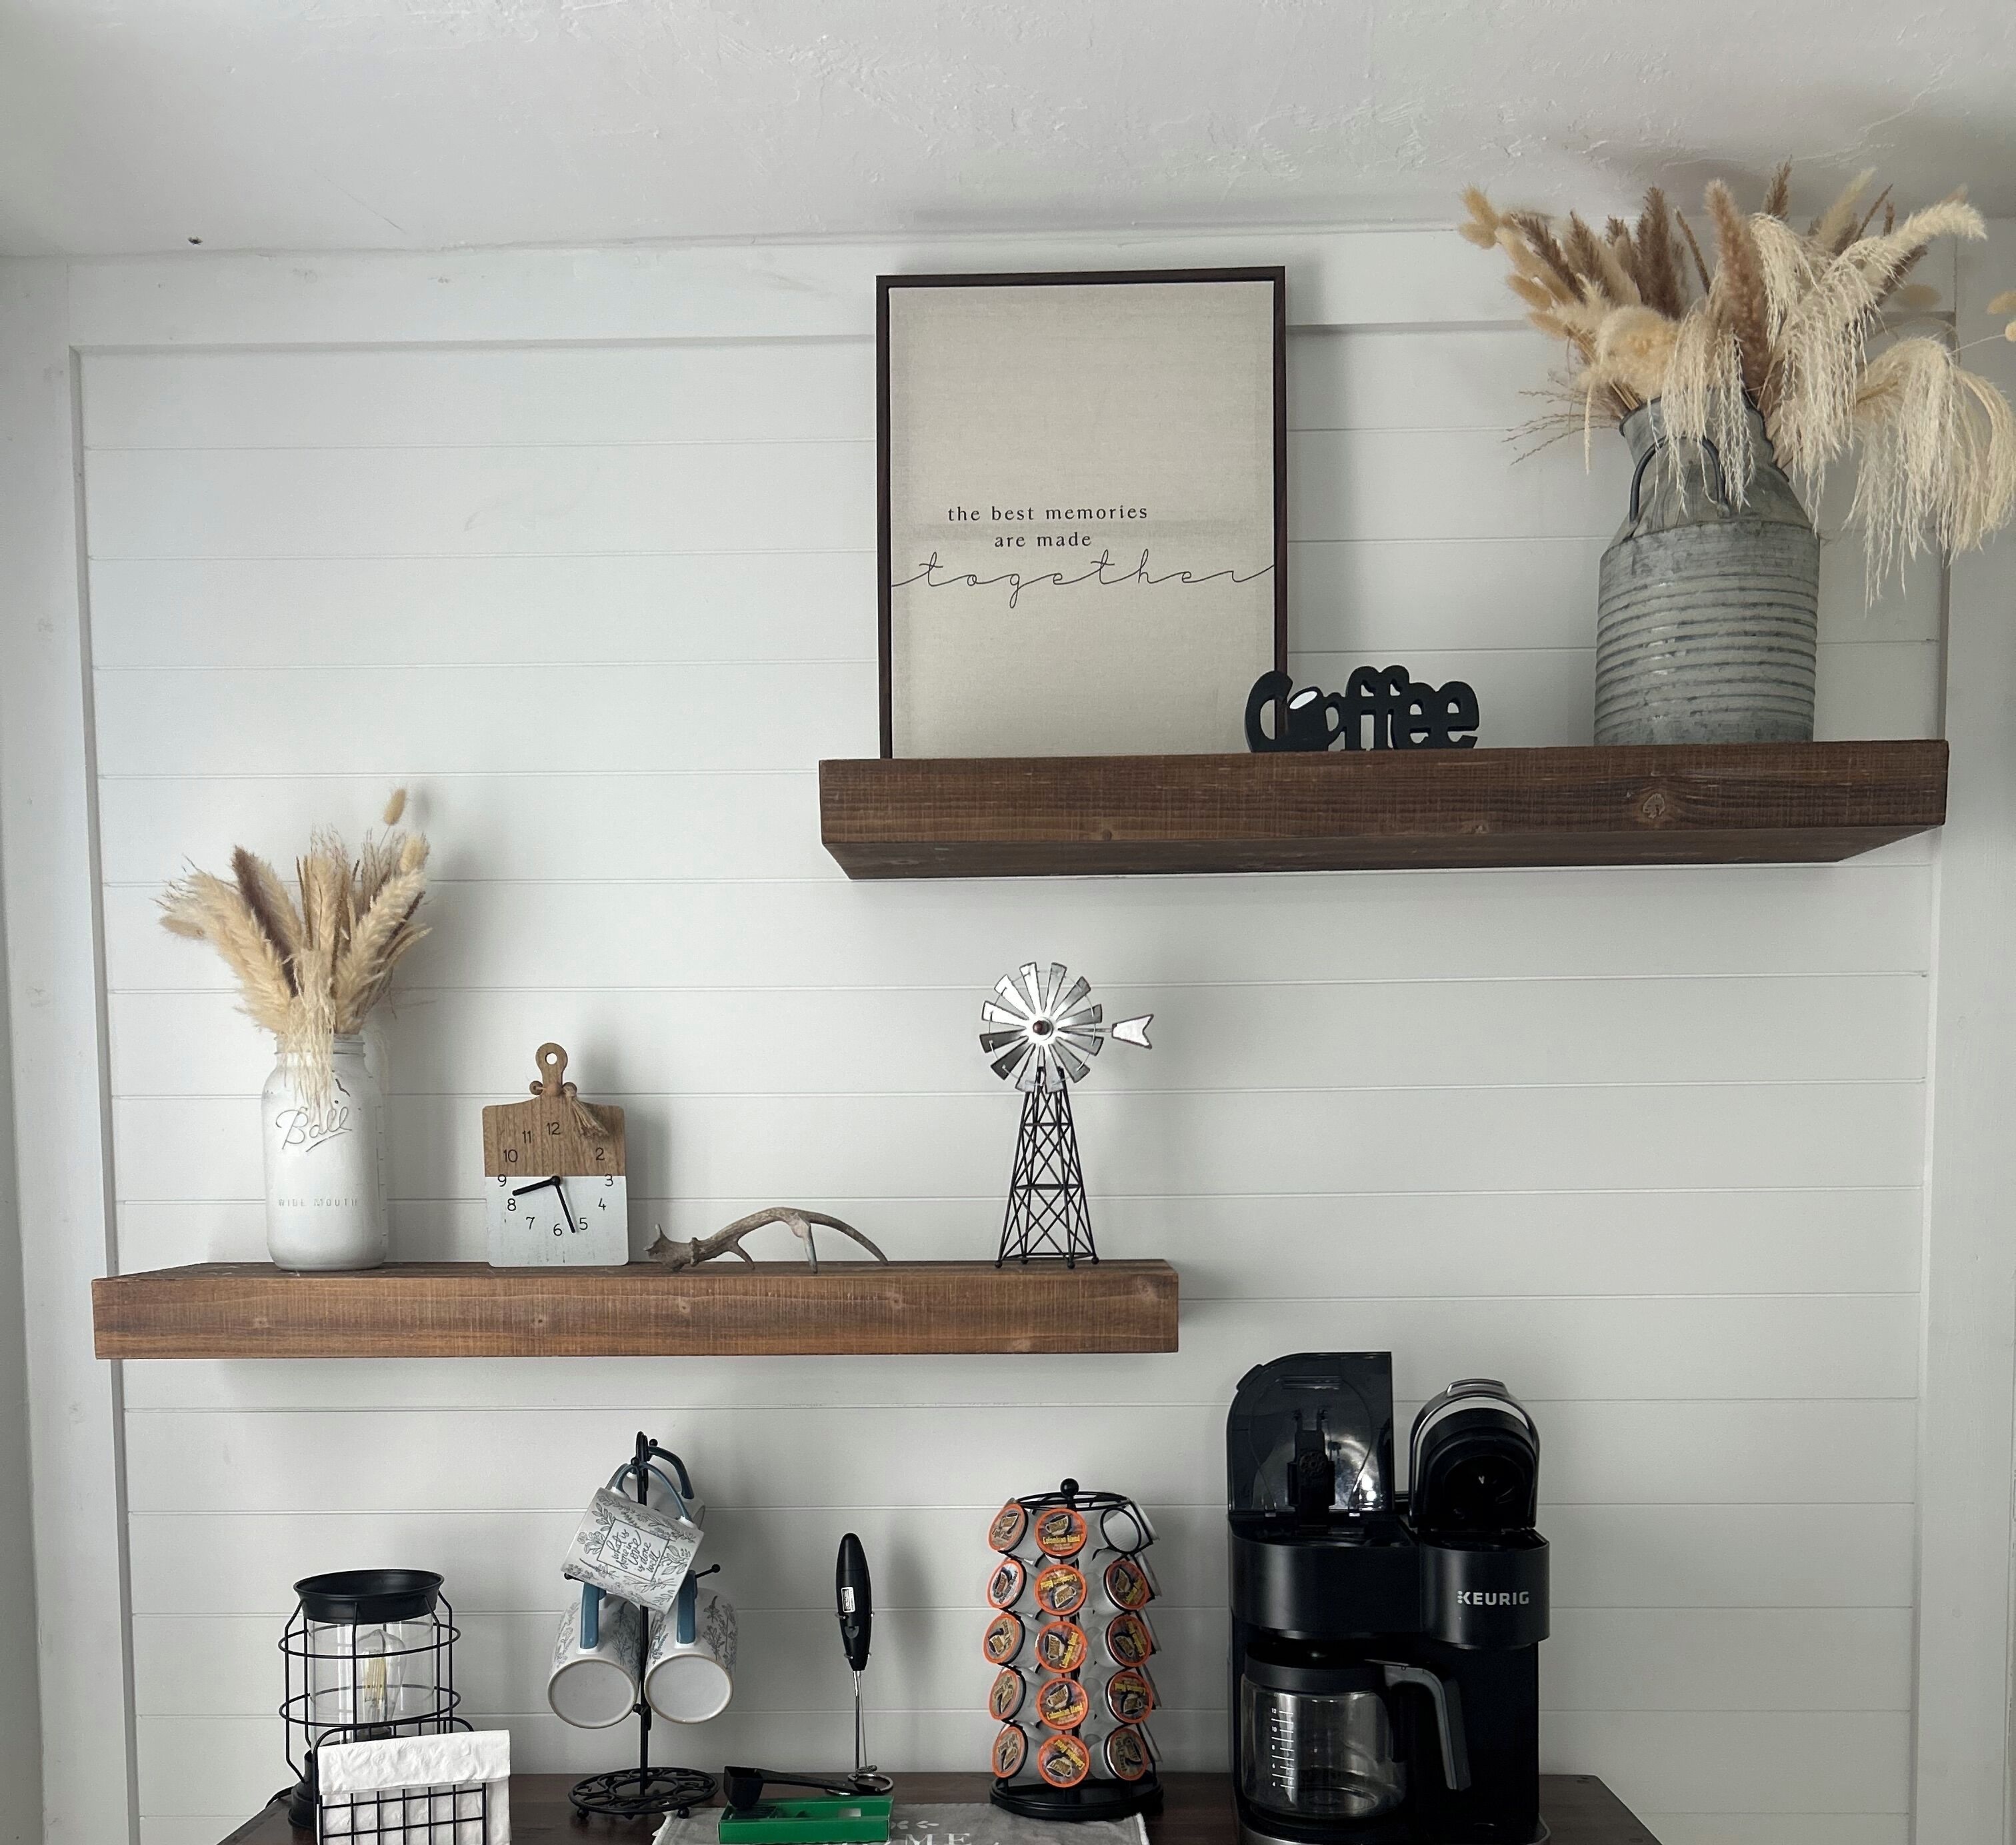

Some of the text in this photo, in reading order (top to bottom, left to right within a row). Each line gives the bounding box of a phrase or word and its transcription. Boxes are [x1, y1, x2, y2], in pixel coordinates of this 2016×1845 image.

[947, 505, 1147, 521] the best memories
[994, 532, 1092, 548] are made
[891, 549, 1274, 608] together
[1244, 665, 1479, 753] Coffee
[275, 1106, 353, 1150] Ball
[546, 1122, 560, 1136] 12
[522, 1130, 531, 1144] 11
[503, 1149, 518, 1162] 10
[595, 1147, 605, 1160] 2
[497, 1174, 507, 1187] 9
[605, 1174, 613, 1186] 3
[314, 1198, 358, 1207] MOUTH
[507, 1198, 516, 1211] 8
[598, 1198, 606, 1210] 4
[526, 1216, 535, 1230] 7
[553, 1223, 563, 1236] 6
[579, 1217, 588, 1230] 5
[1457, 1590, 1530, 1606] KEURIG
